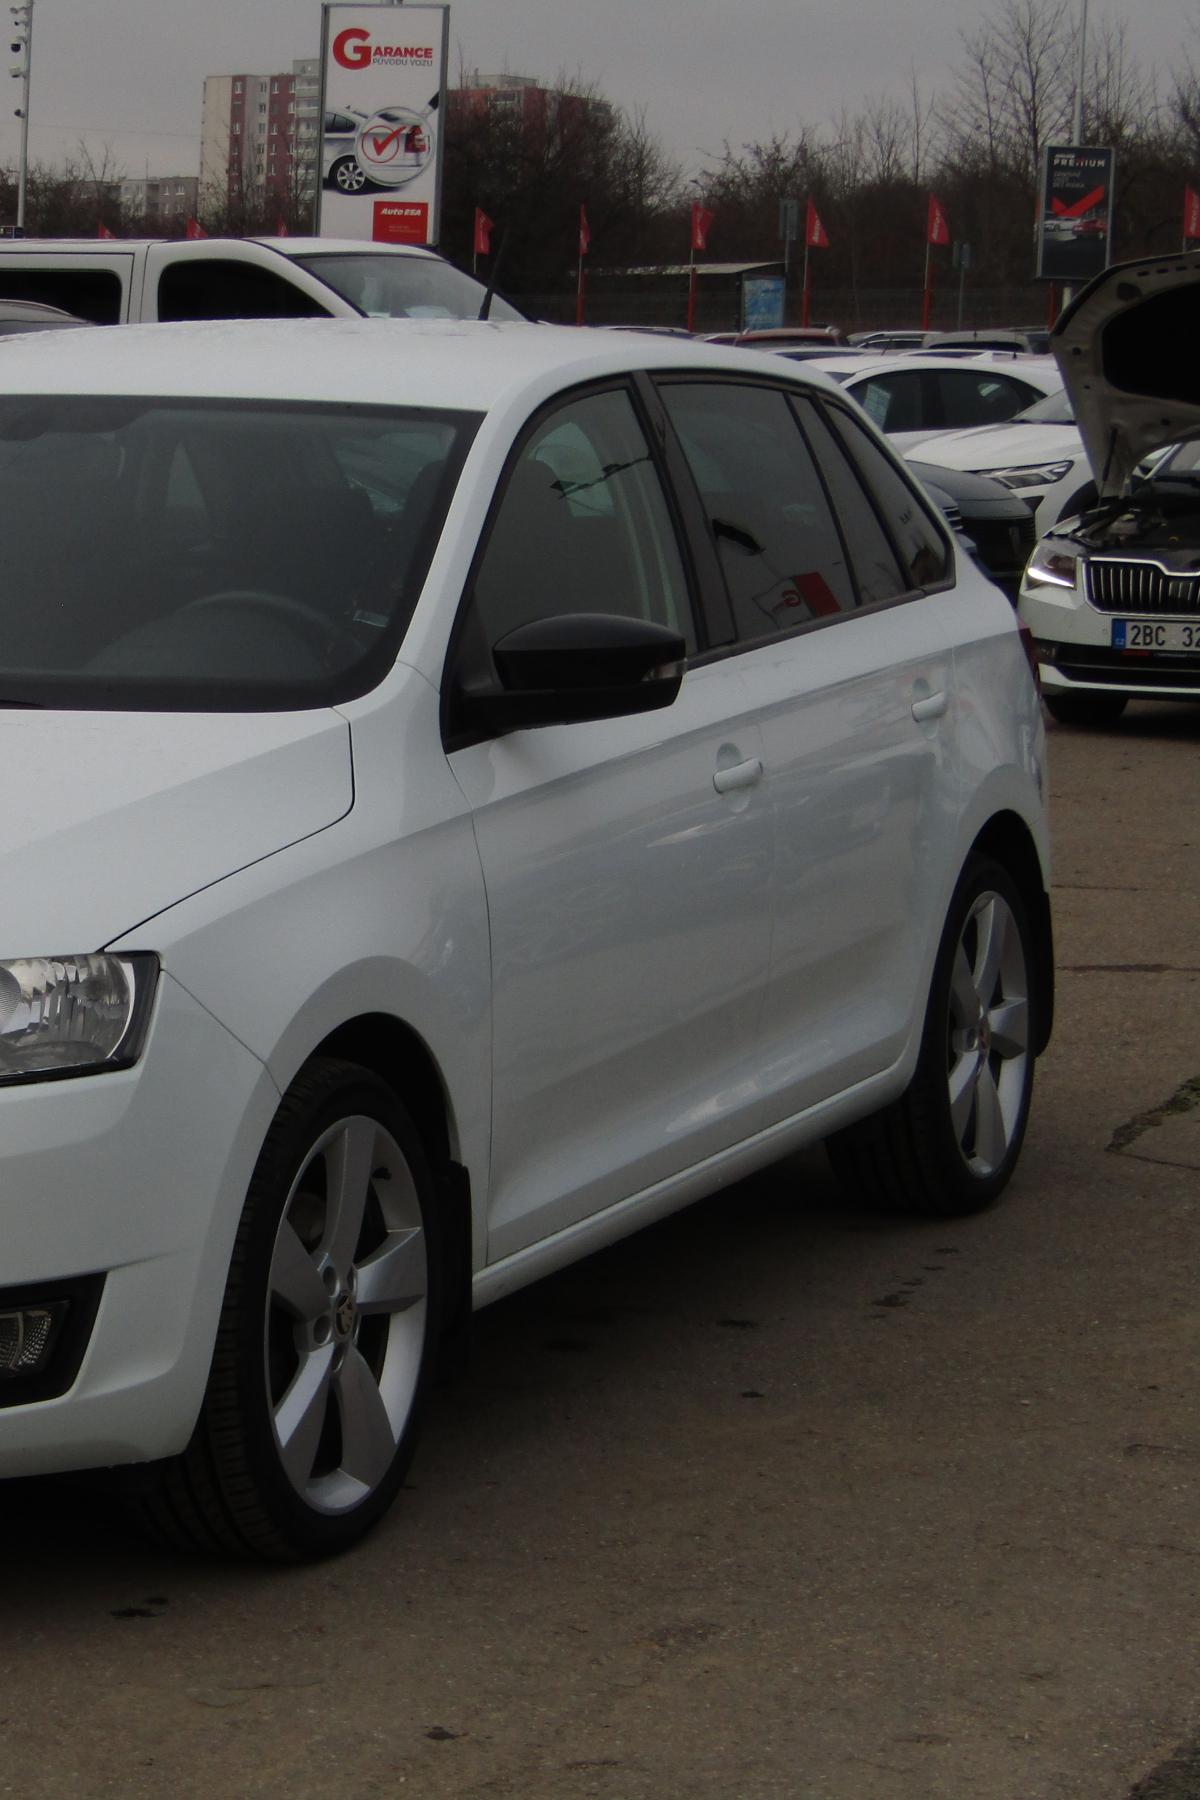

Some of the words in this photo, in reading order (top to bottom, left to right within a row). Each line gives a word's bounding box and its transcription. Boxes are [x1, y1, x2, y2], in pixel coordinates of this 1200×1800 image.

[333, 28, 433, 70] GARANCE
[381, 208, 403, 216] Auto
[404, 208, 422, 217] ESA
[1130, 625, 1166, 647] 2BC
